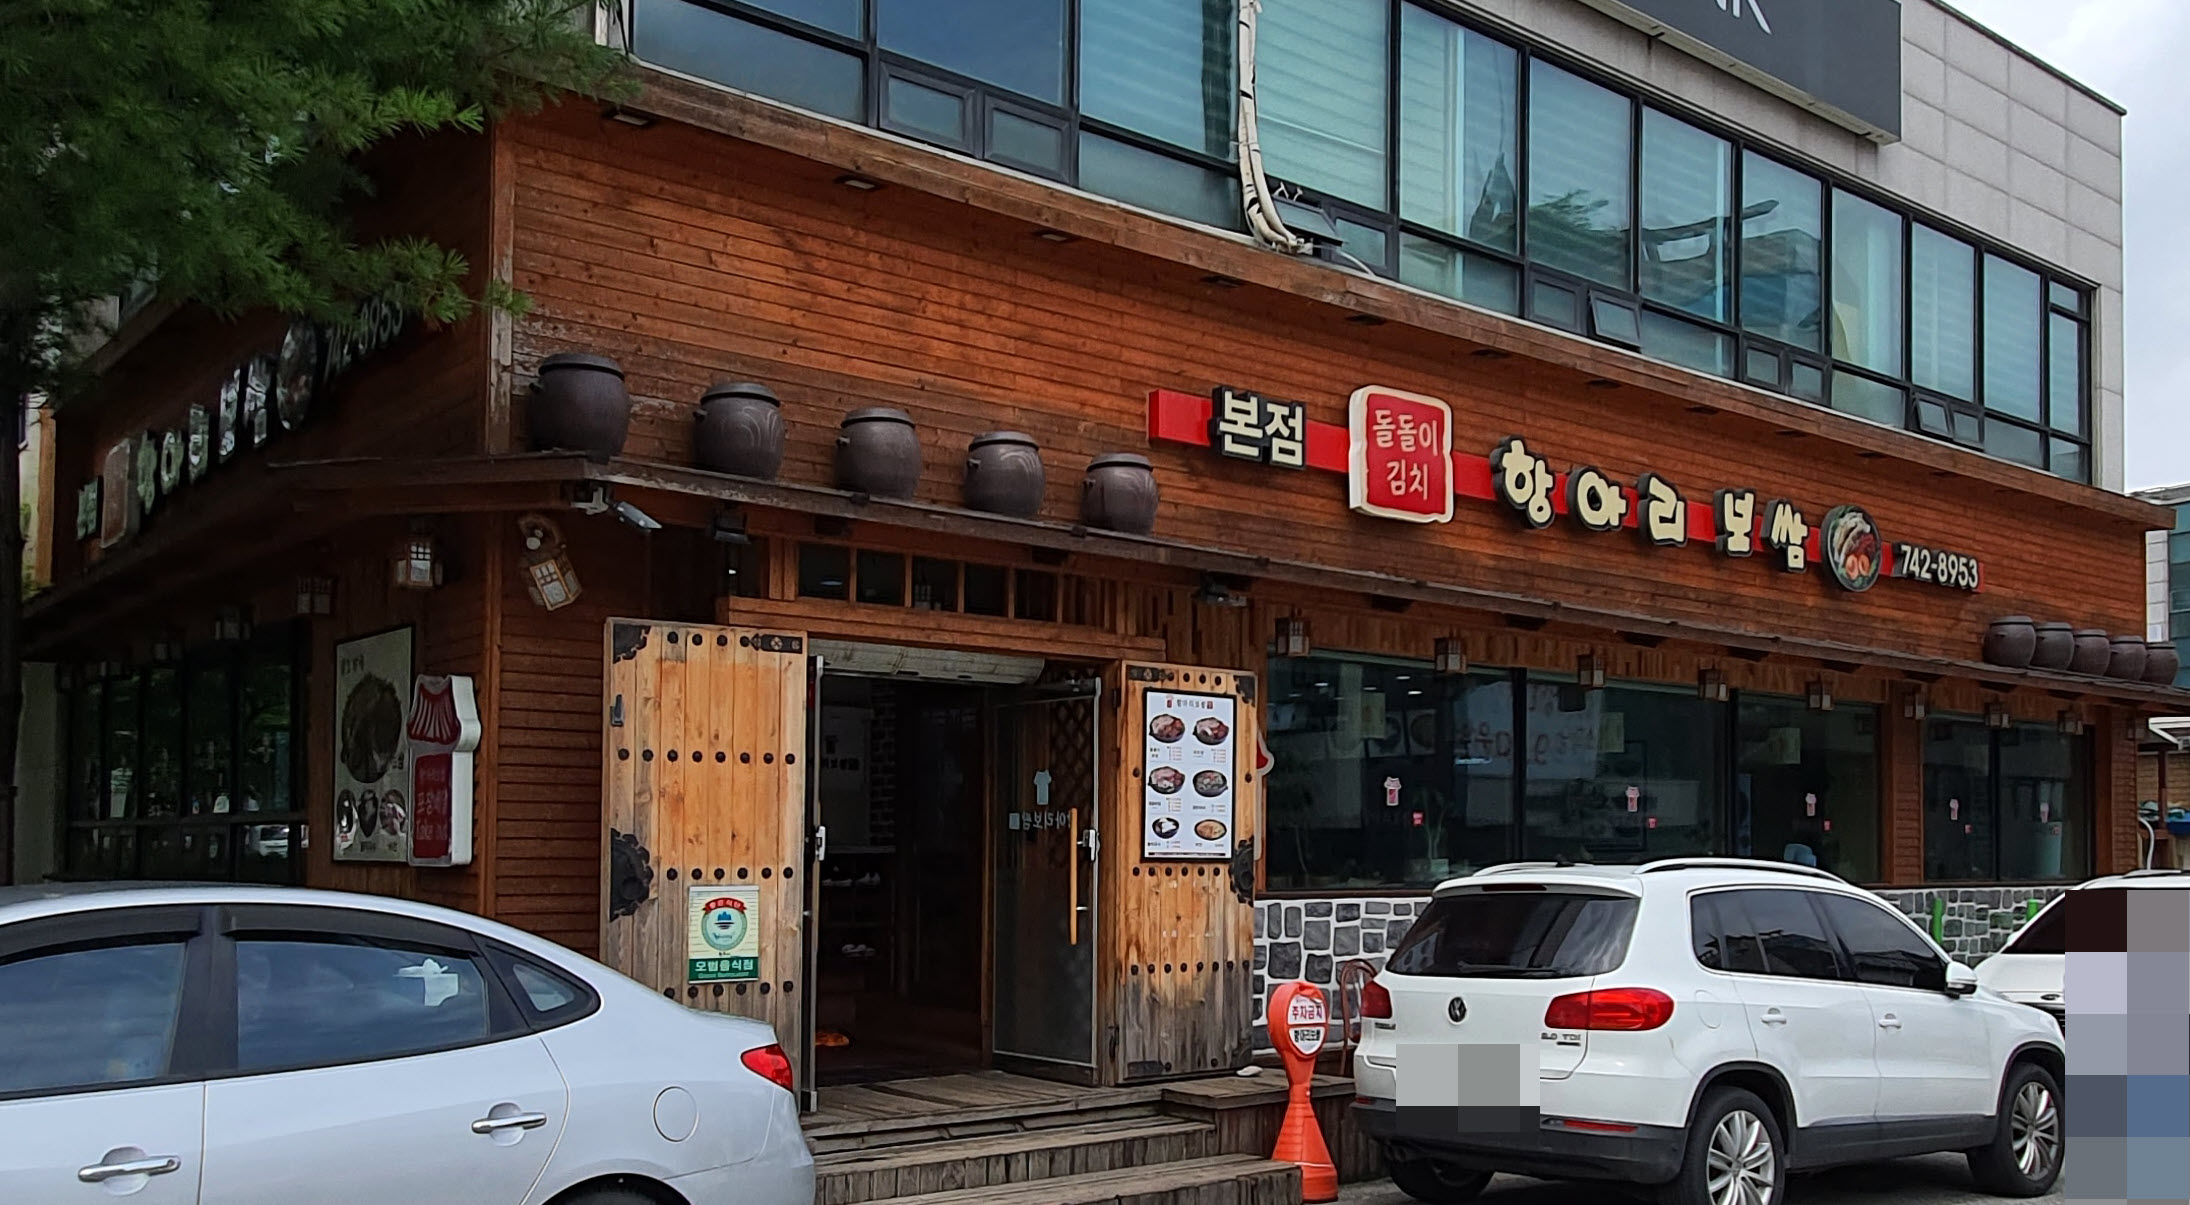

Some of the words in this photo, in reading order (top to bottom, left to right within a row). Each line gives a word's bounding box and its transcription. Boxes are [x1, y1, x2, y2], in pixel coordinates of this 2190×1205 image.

[1219, 391, 1304, 467] 본점
[1373, 409, 1439, 456] 돌돌이
[1386, 461, 1429, 500] 김치
[1502, 439, 1685, 544] 항아리
[1723, 492, 1809, 569] 보쌈
[1900, 544, 1979, 588] 742-8953
[1292, 1005, 1323, 1020] 주차금지
[1563, 1033, 1582, 1041] TDI
